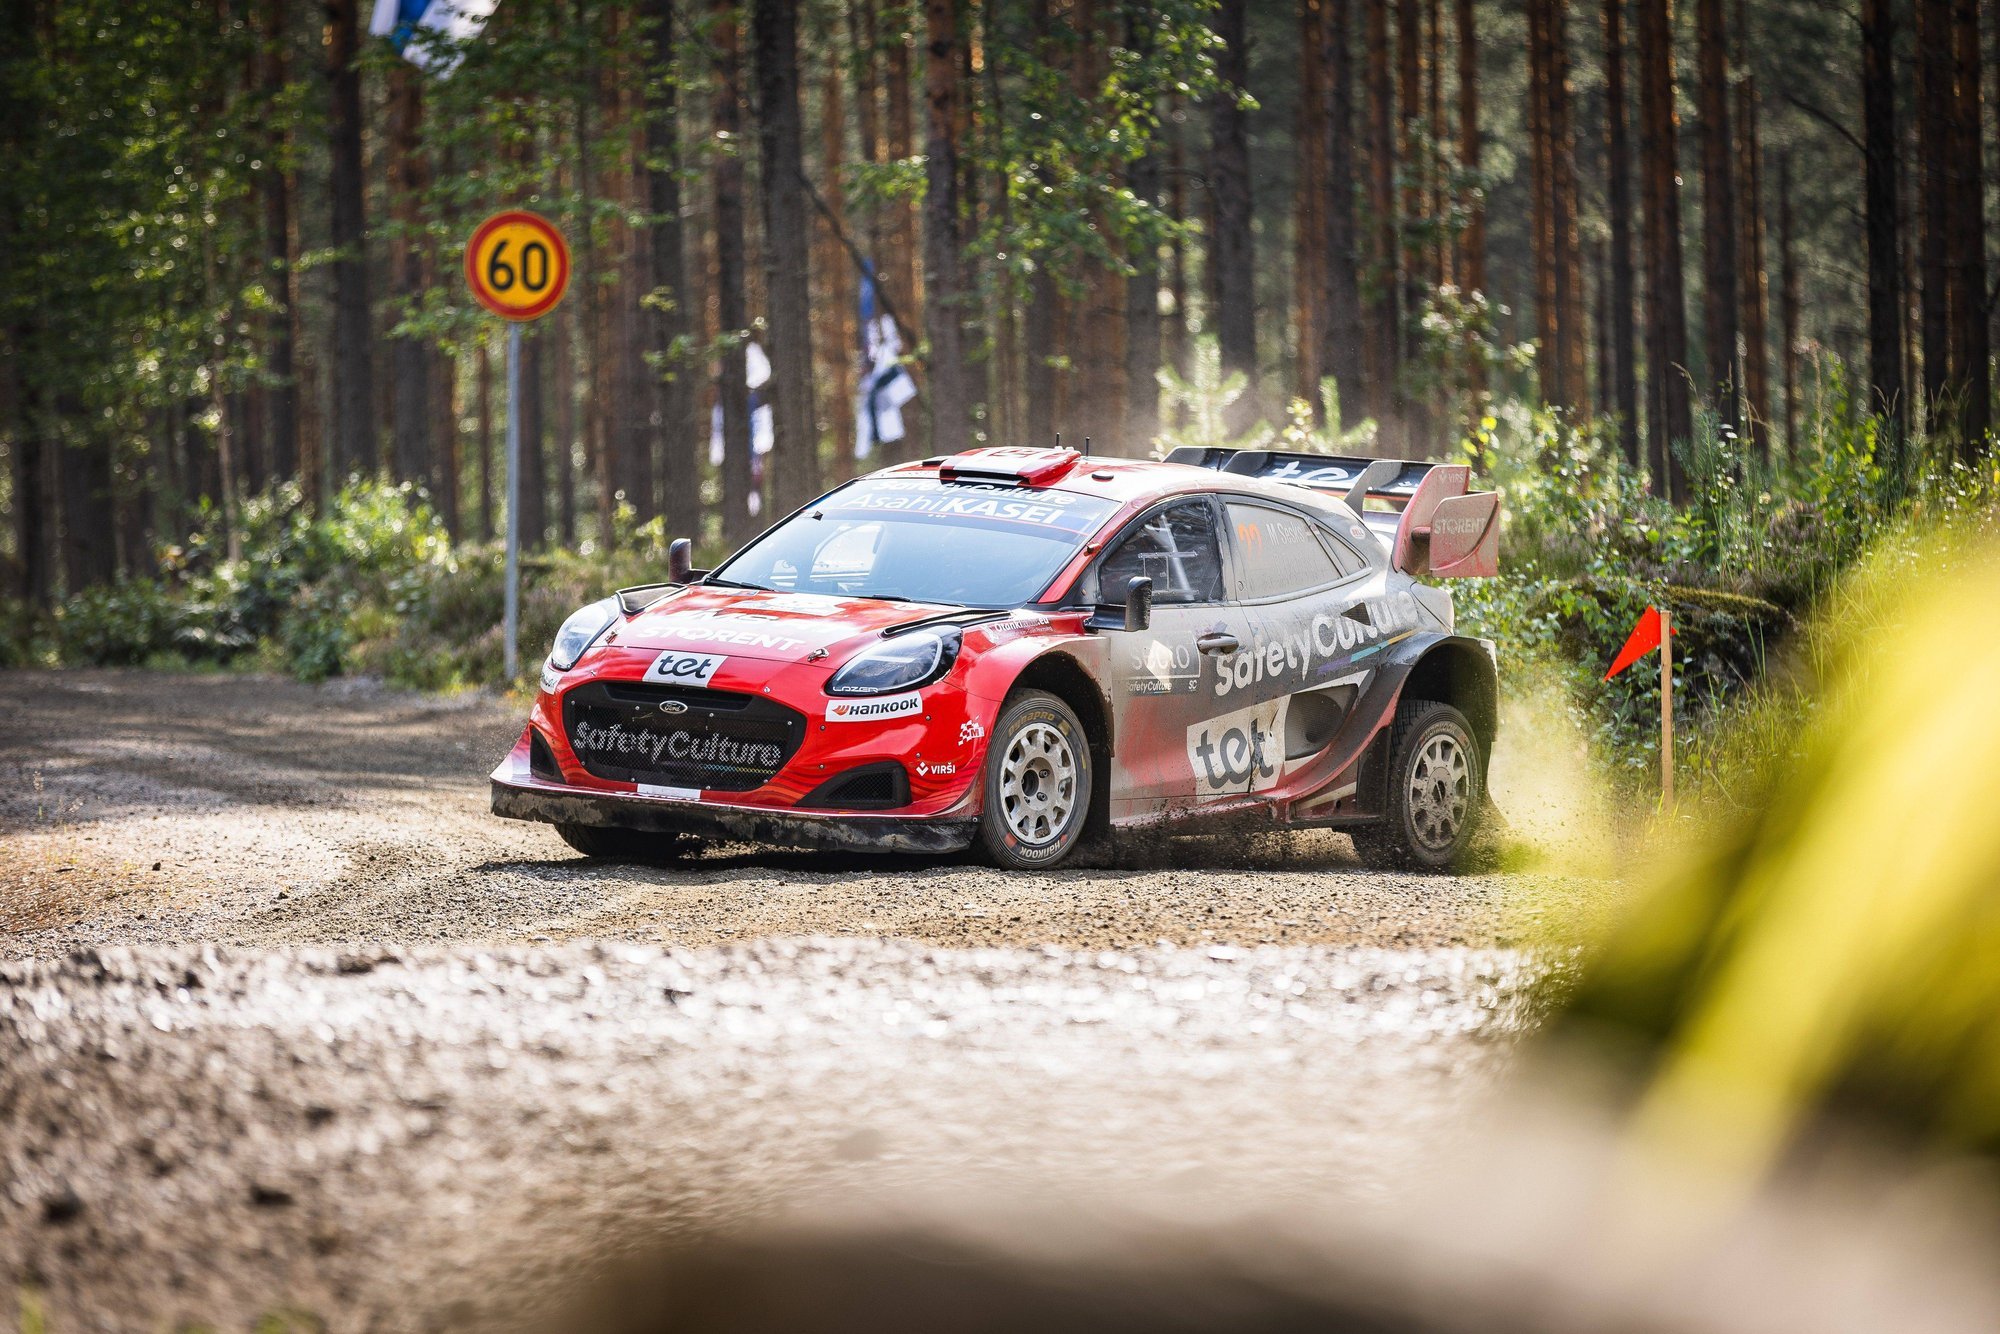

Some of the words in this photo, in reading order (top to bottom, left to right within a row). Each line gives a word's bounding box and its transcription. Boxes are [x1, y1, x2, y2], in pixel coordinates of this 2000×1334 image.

[488, 239, 548, 291] 60
[636, 626, 807, 652] STORENT
[656, 655, 712, 679] tet
[664, 702, 681, 712] Ford
[573, 721, 782, 767] SafetyCulture
[1196, 718, 1275, 790] tet
[930, 762, 956, 775] VIRŠI
